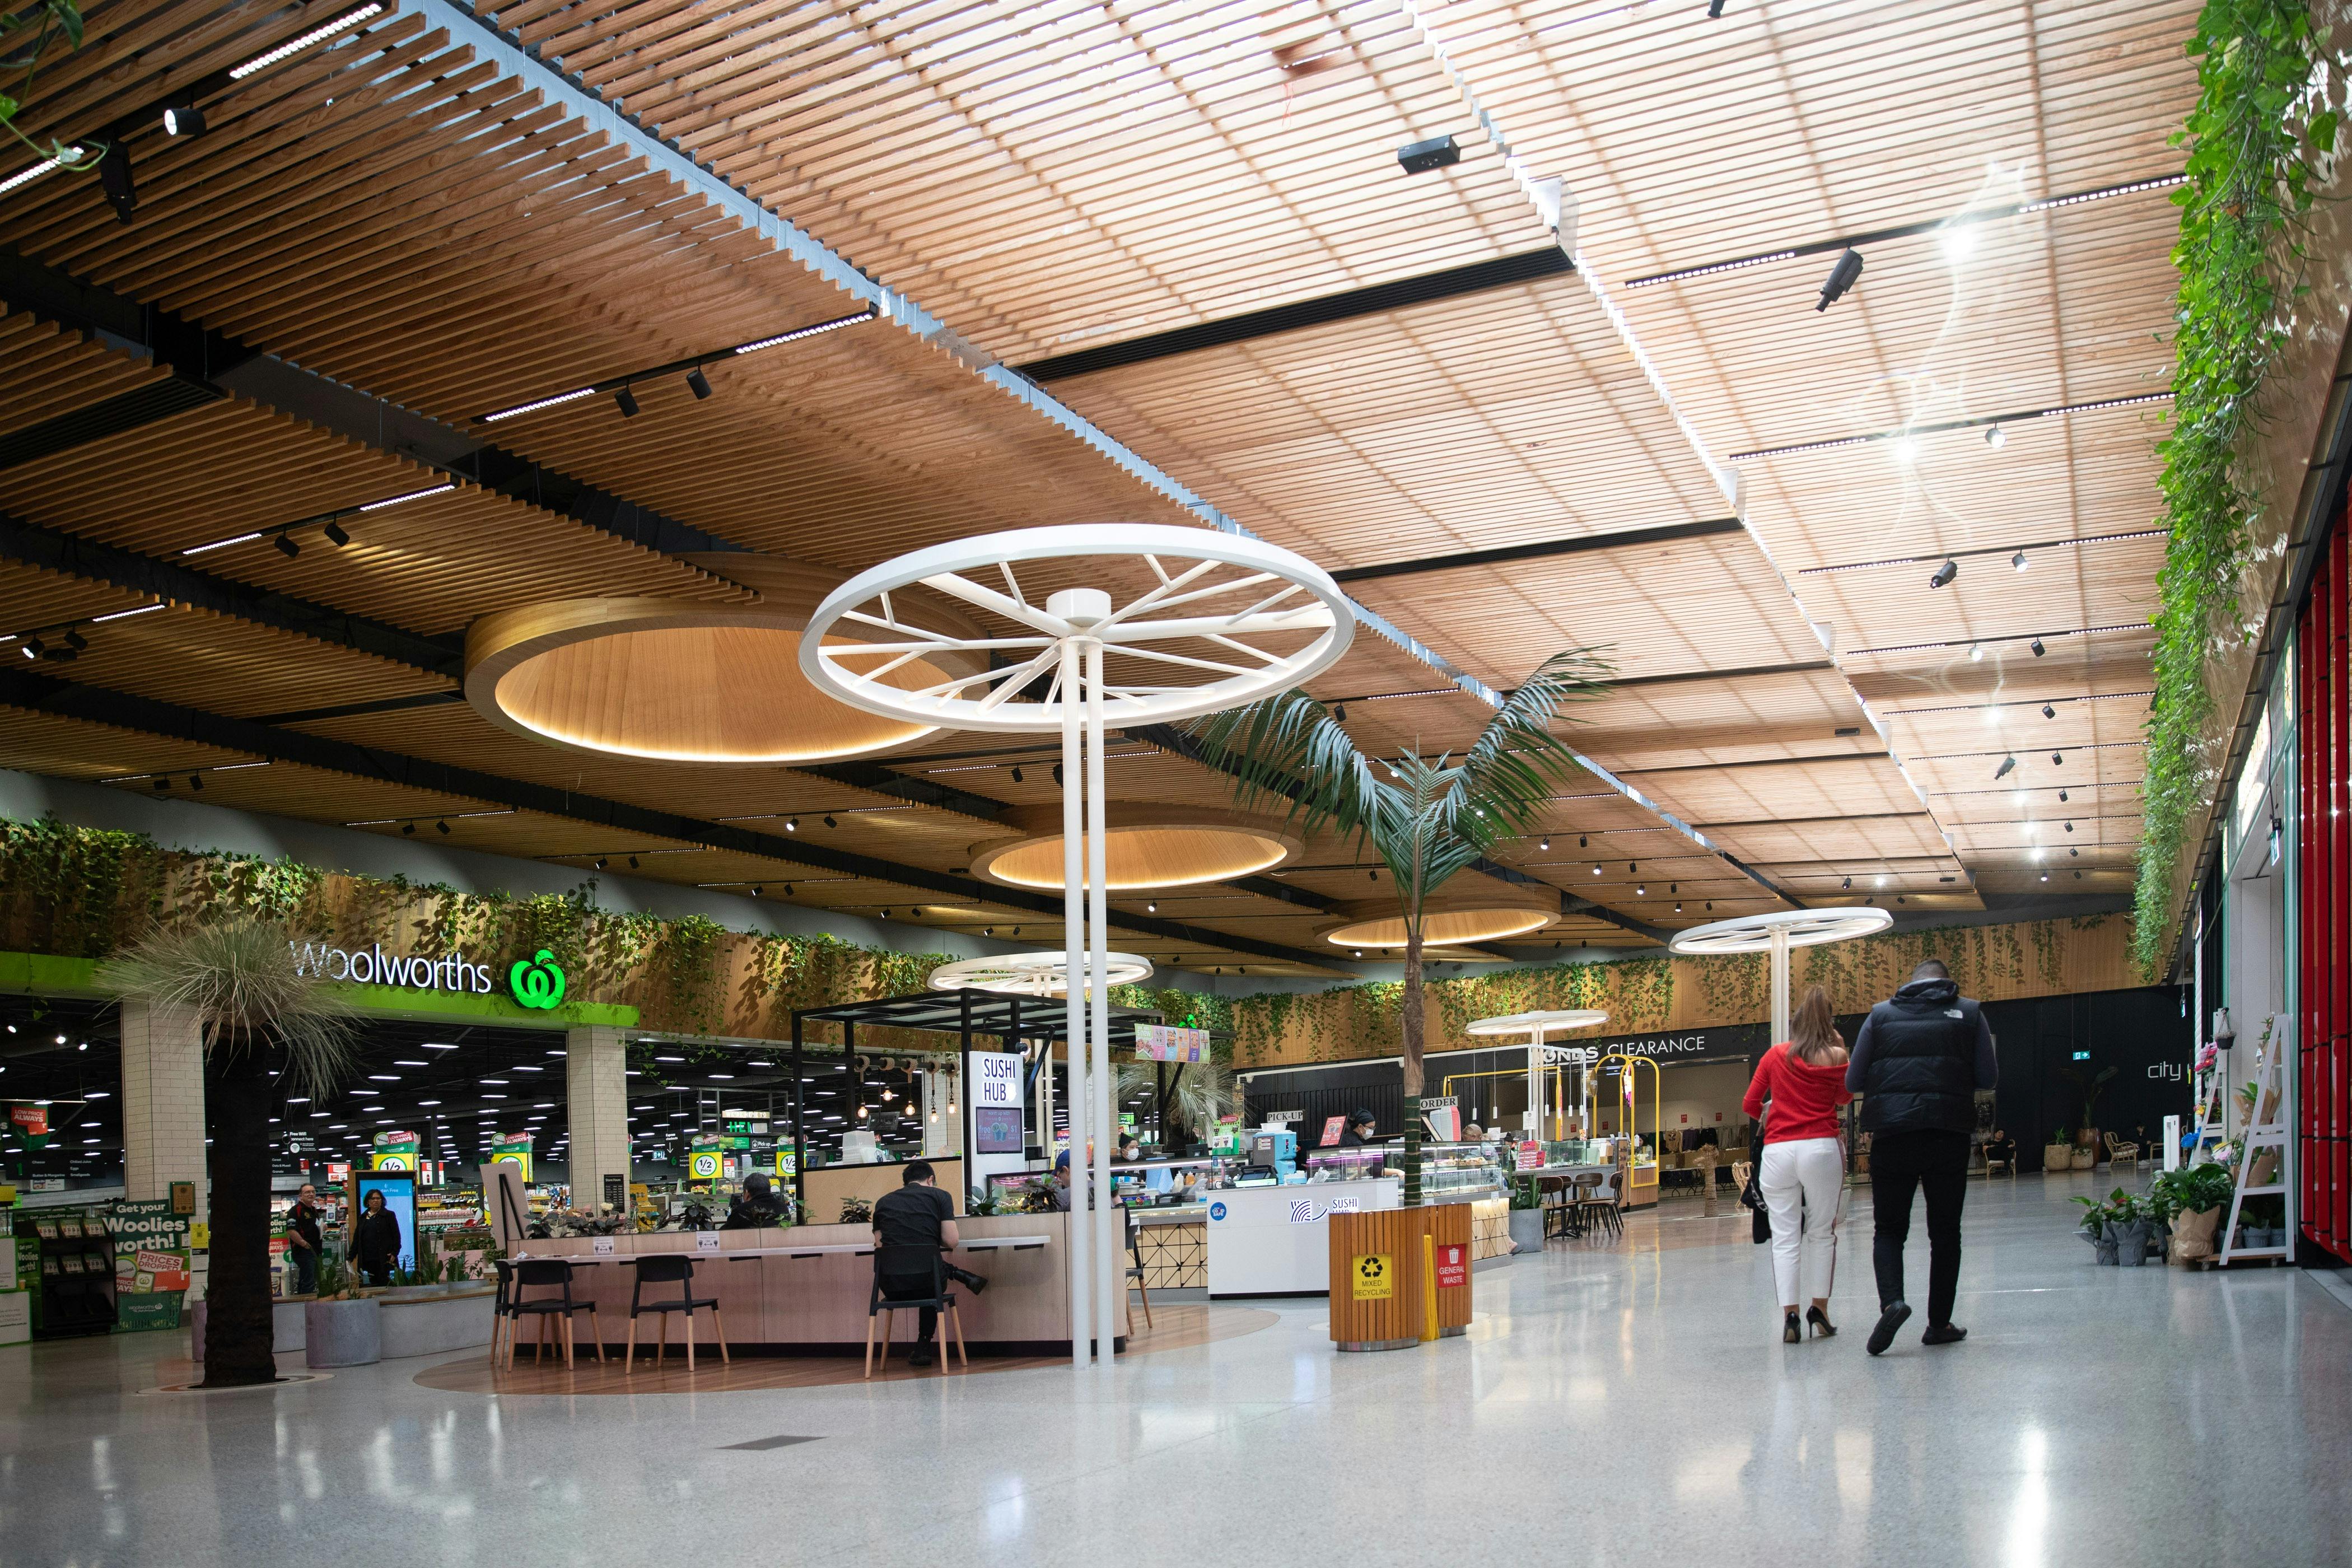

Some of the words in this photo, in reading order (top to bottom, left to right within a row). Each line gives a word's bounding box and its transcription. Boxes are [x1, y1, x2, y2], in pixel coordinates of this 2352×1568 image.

[290, 941, 491, 993] Woolworths
[1543, 1047, 1598, 1063] ONDS
[1607, 1037, 1705, 1056] CLEARANCE
[984, 1058, 1015, 1078] SUSHI
[2148, 1061, 2181, 1081] city
[984, 1082, 1006, 1101] HUB
[1421, 1098, 1456, 1108] ORDER
[1268, 1112, 1303, 1121] PICK-UP
[356, 1158, 364, 1169] 3
[671, 1156, 677, 1165] 6
[699, 1159, 712, 1169] 1/2
[755, 1156, 760, 1164] 7
[17, 1163, 23, 1175] 1
[385, 1162, 400, 1170] 1/2
[1333, 1198, 1357, 1208] SUSHI
[116, 1205, 139, 1214] Get
[140, 1203, 166, 1214] your
[101, 1216, 186, 1233] Woolies
[140, 1253, 180, 1266] PRICES
[138, 1261, 179, 1271] DROPPED
[1439, 1266, 1464, 1275] GENERAL
[1443, 1275, 1463, 1284] WASTE
